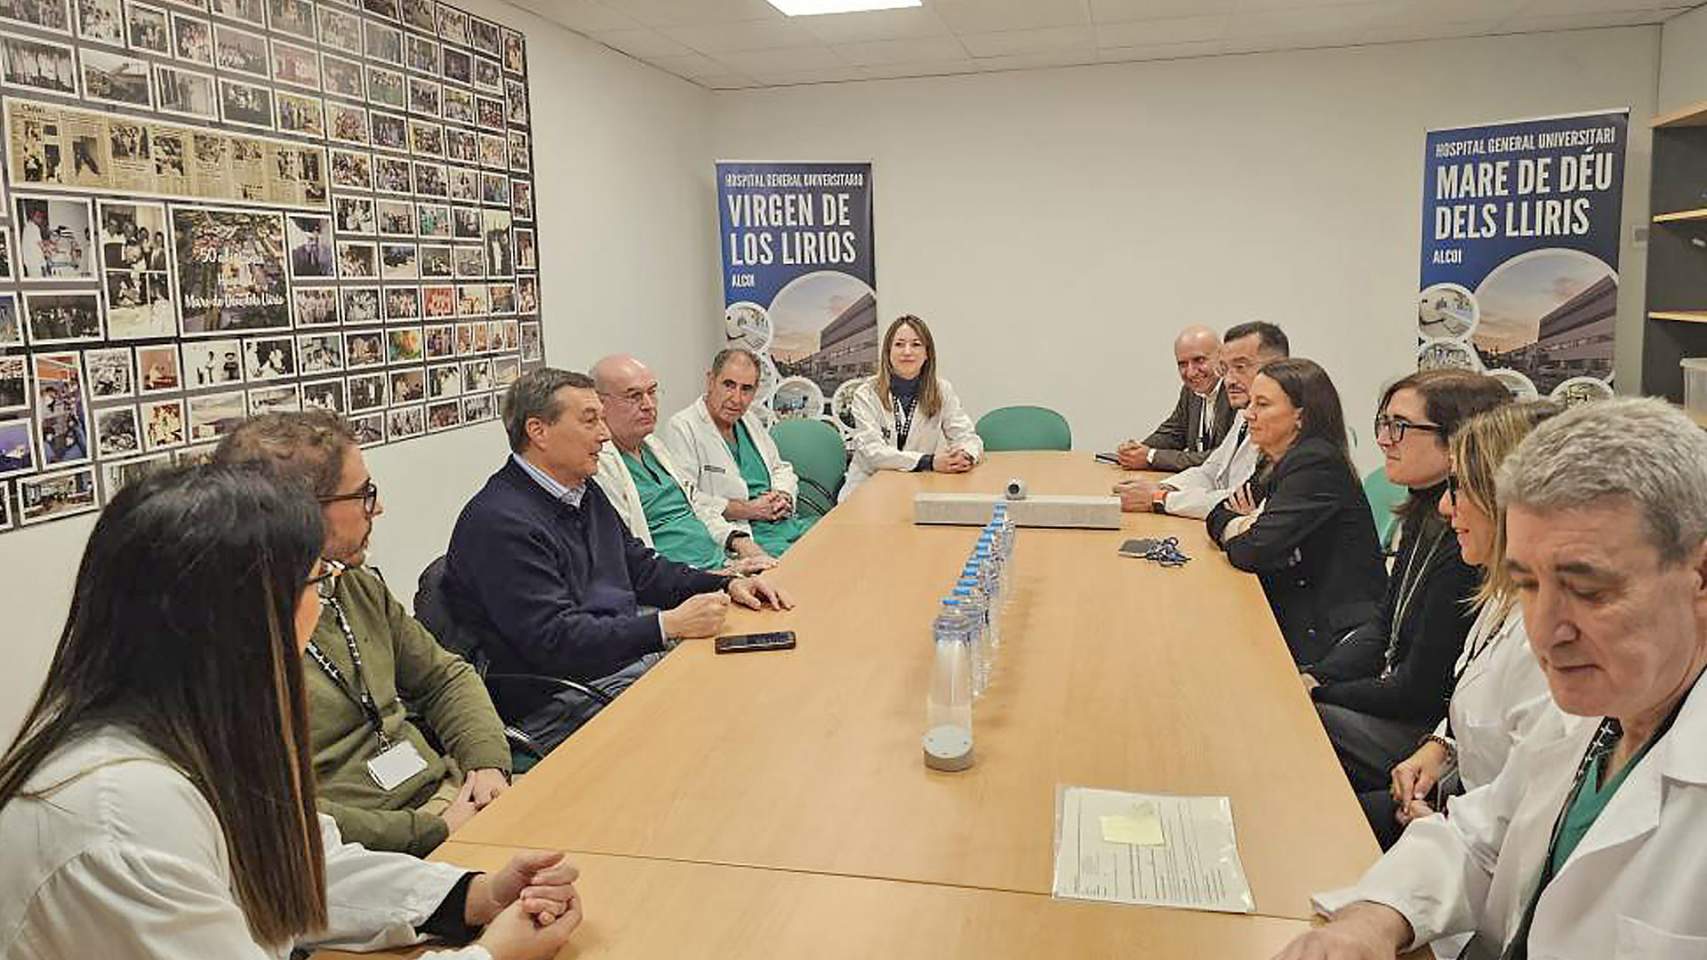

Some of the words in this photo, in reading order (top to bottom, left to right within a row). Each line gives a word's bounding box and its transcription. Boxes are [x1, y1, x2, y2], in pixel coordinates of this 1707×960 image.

[1435, 138, 1486, 158] HOSPITAL
[1488, 133, 1535, 153] GENERAL
[1538, 126, 1616, 149] UNIVERSITARI
[725, 174, 766, 188] HOSPITAL
[767, 174, 801, 187] GENERAL
[803, 173, 863, 186] UNIVERSITARIO
[1436, 161, 1510, 200] MARE
[1518, 157, 1553, 194] DE
[1560, 146, 1613, 192] DÉU
[727, 194, 814, 227] VIRGEN
[823, 193, 850, 226] DE
[1435, 203, 1498, 240] DELS
[1505, 198, 1590, 237] LLIRIS
[731, 232, 774, 266] LOS
[781, 231, 857, 265] LIRIOS
[1433, 249, 1462, 265] ALCOI
